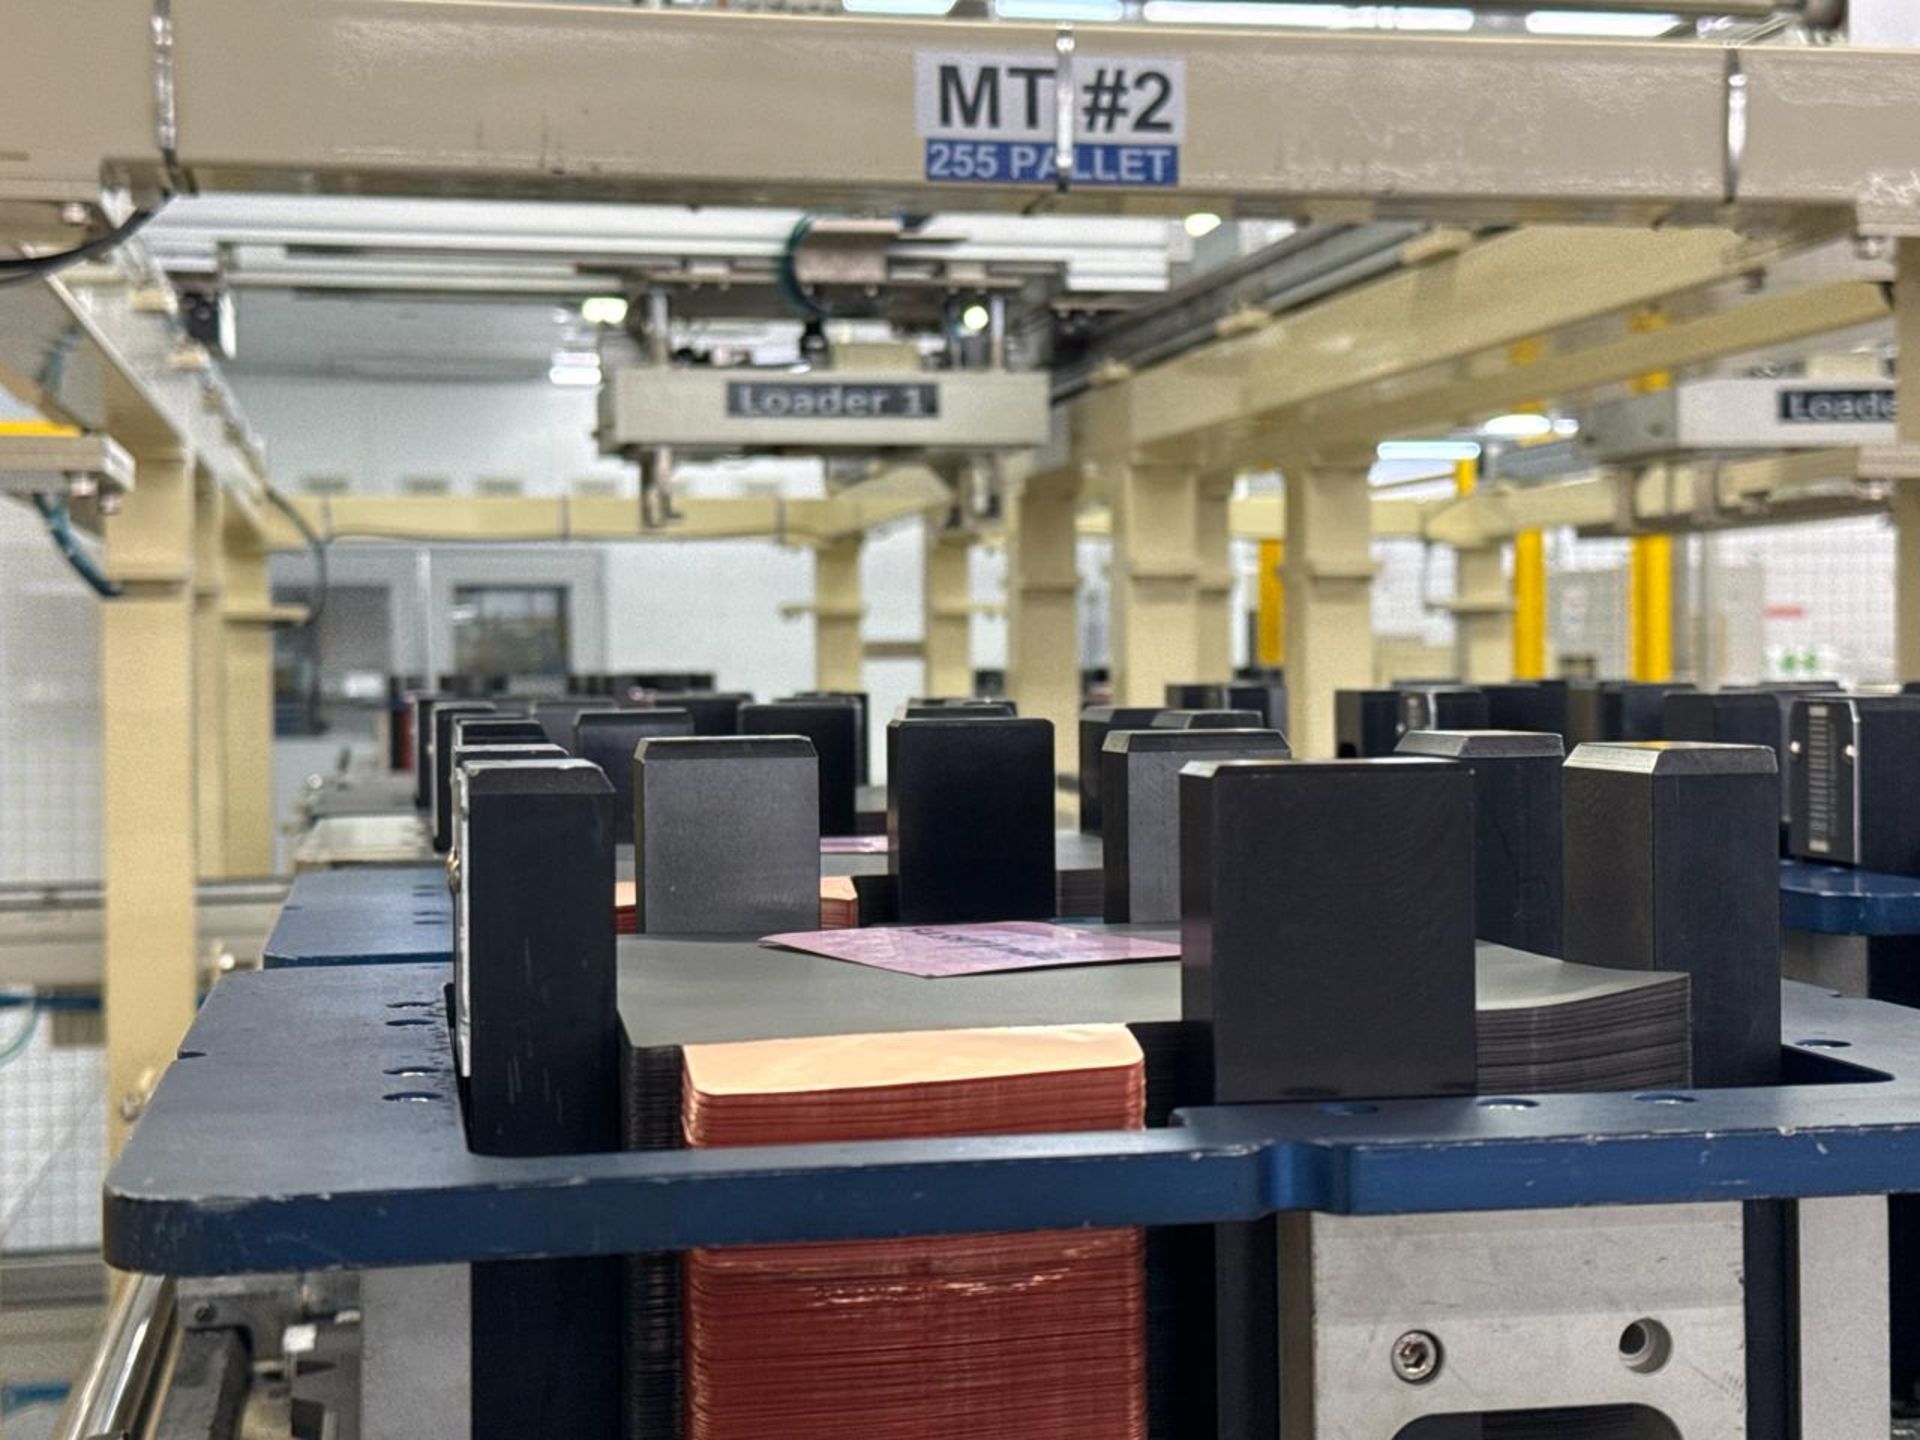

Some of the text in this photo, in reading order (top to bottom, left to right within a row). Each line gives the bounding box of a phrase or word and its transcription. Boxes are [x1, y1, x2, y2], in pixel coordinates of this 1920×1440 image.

[938, 65, 1173, 132] MT #2
[929, 145, 1171, 181] 255 PALLET
[738, 385, 924, 416] Loader 1
